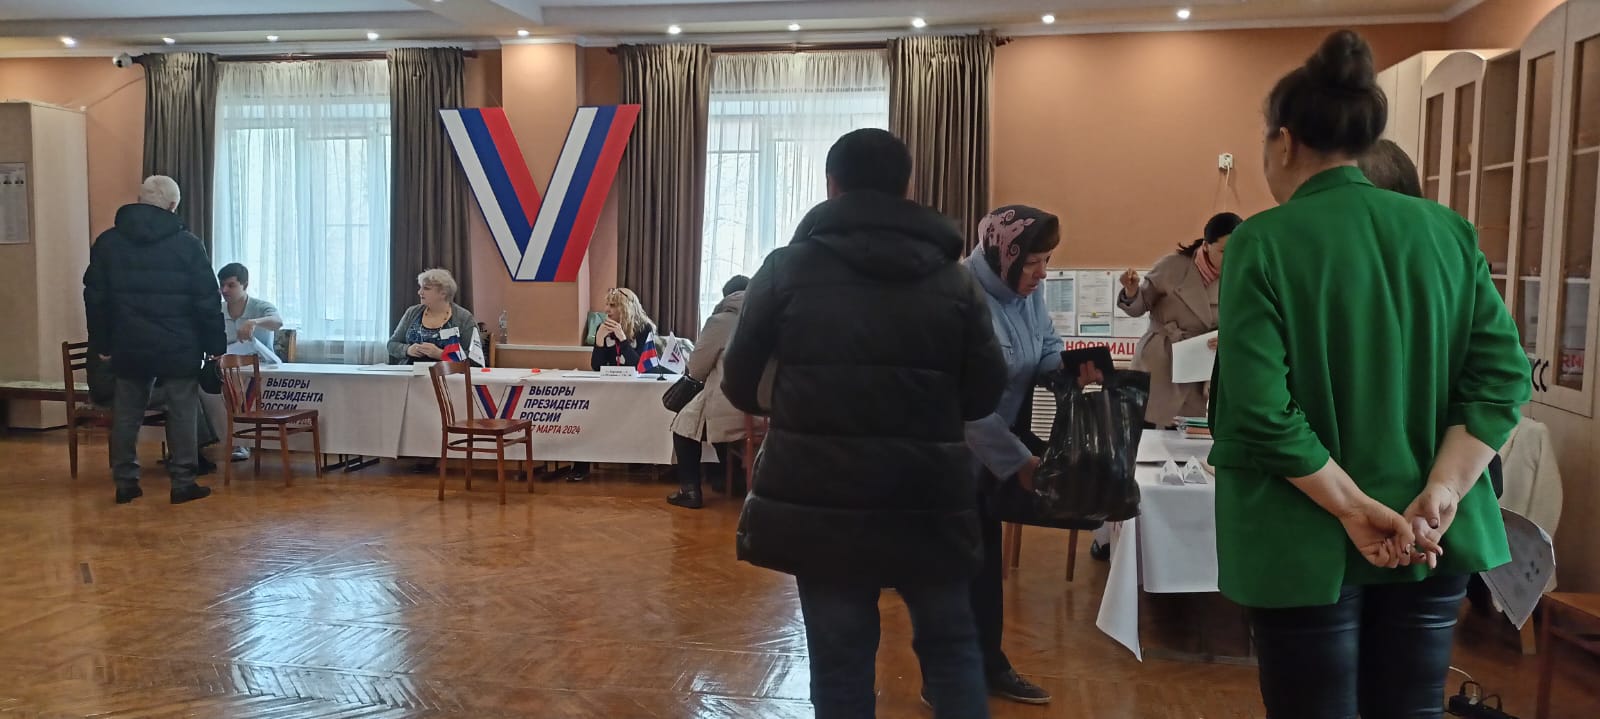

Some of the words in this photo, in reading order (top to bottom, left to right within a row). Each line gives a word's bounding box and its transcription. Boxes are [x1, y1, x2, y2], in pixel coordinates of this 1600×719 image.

[266, 377, 310, 389] ВЫБОРЫ
[528, 385, 576, 396] ВЫБОРЫ
[262, 390, 324, 403] ПРЕЗИДЕНТА
[523, 398, 590, 410] ПРЕЗИДЕНТА
[520, 411, 561, 422] РОССИИ
[536, 425, 562, 434] МАРТА
[562, 426, 580, 434] 2024
